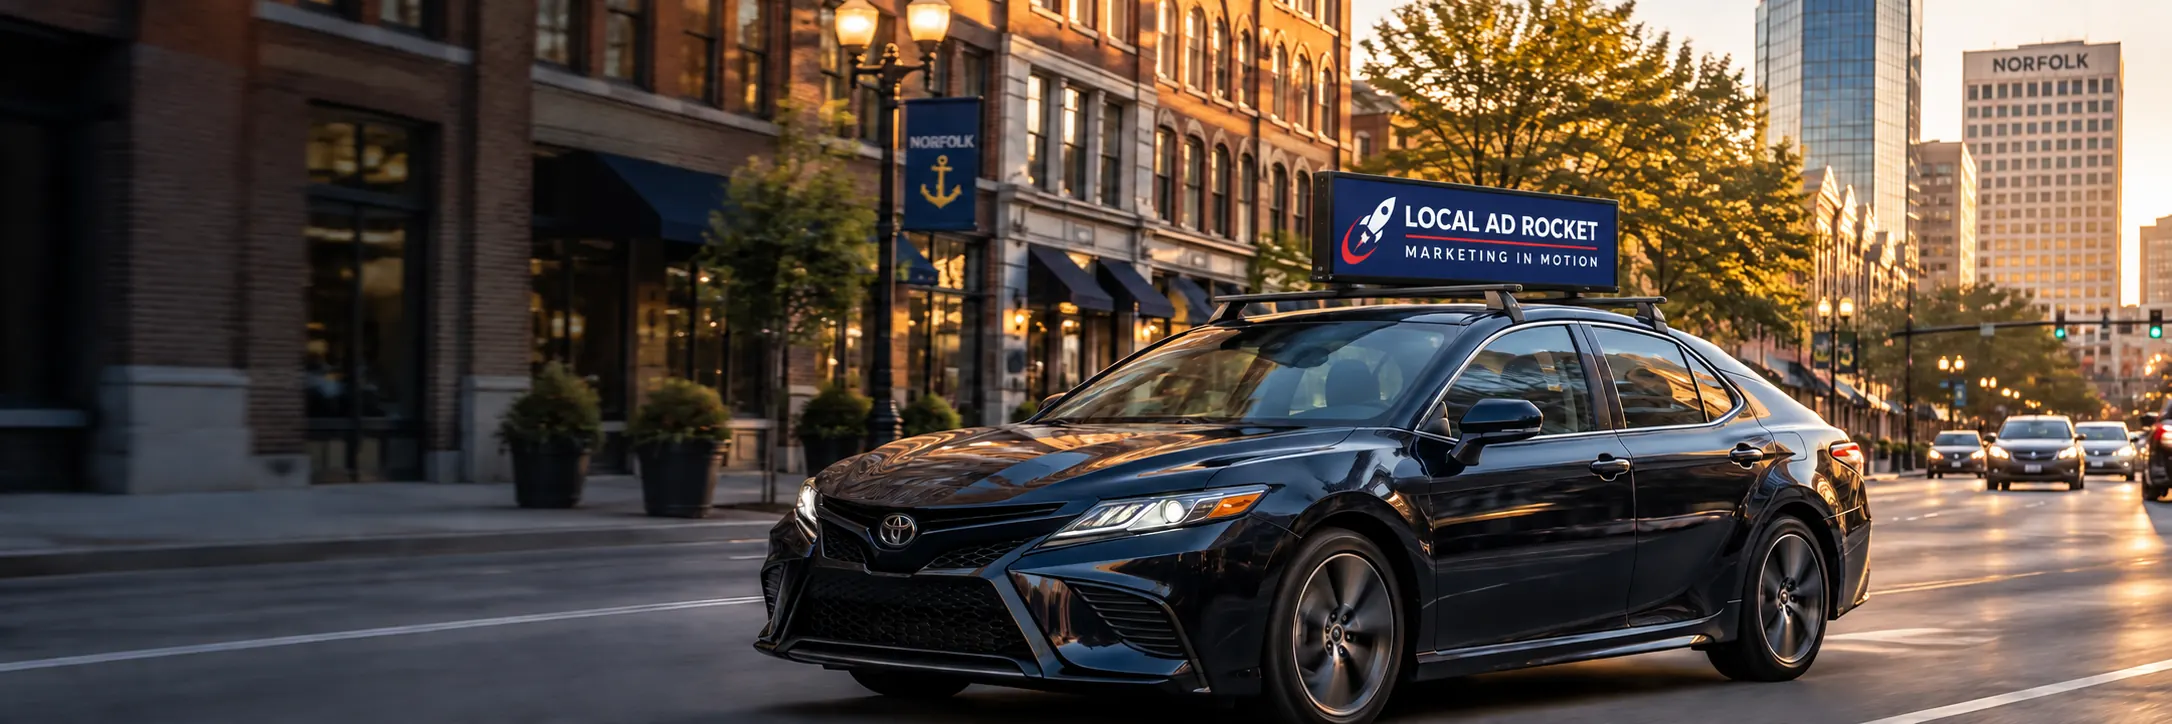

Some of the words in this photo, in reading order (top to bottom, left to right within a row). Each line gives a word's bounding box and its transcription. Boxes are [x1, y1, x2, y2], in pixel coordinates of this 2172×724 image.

[1993, 53, 2089, 72] NORFOLK
[910, 135, 974, 148] NORFOLK
[1405, 205, 1479, 232] LOCAL
[1485, 213, 1516, 234] AD
[1522, 216, 1598, 241] ROCKET
[1405, 245, 1508, 263] MARKETING
[1517, 252, 1532, 265] IN
[1540, 254, 1598, 268] MOTION
